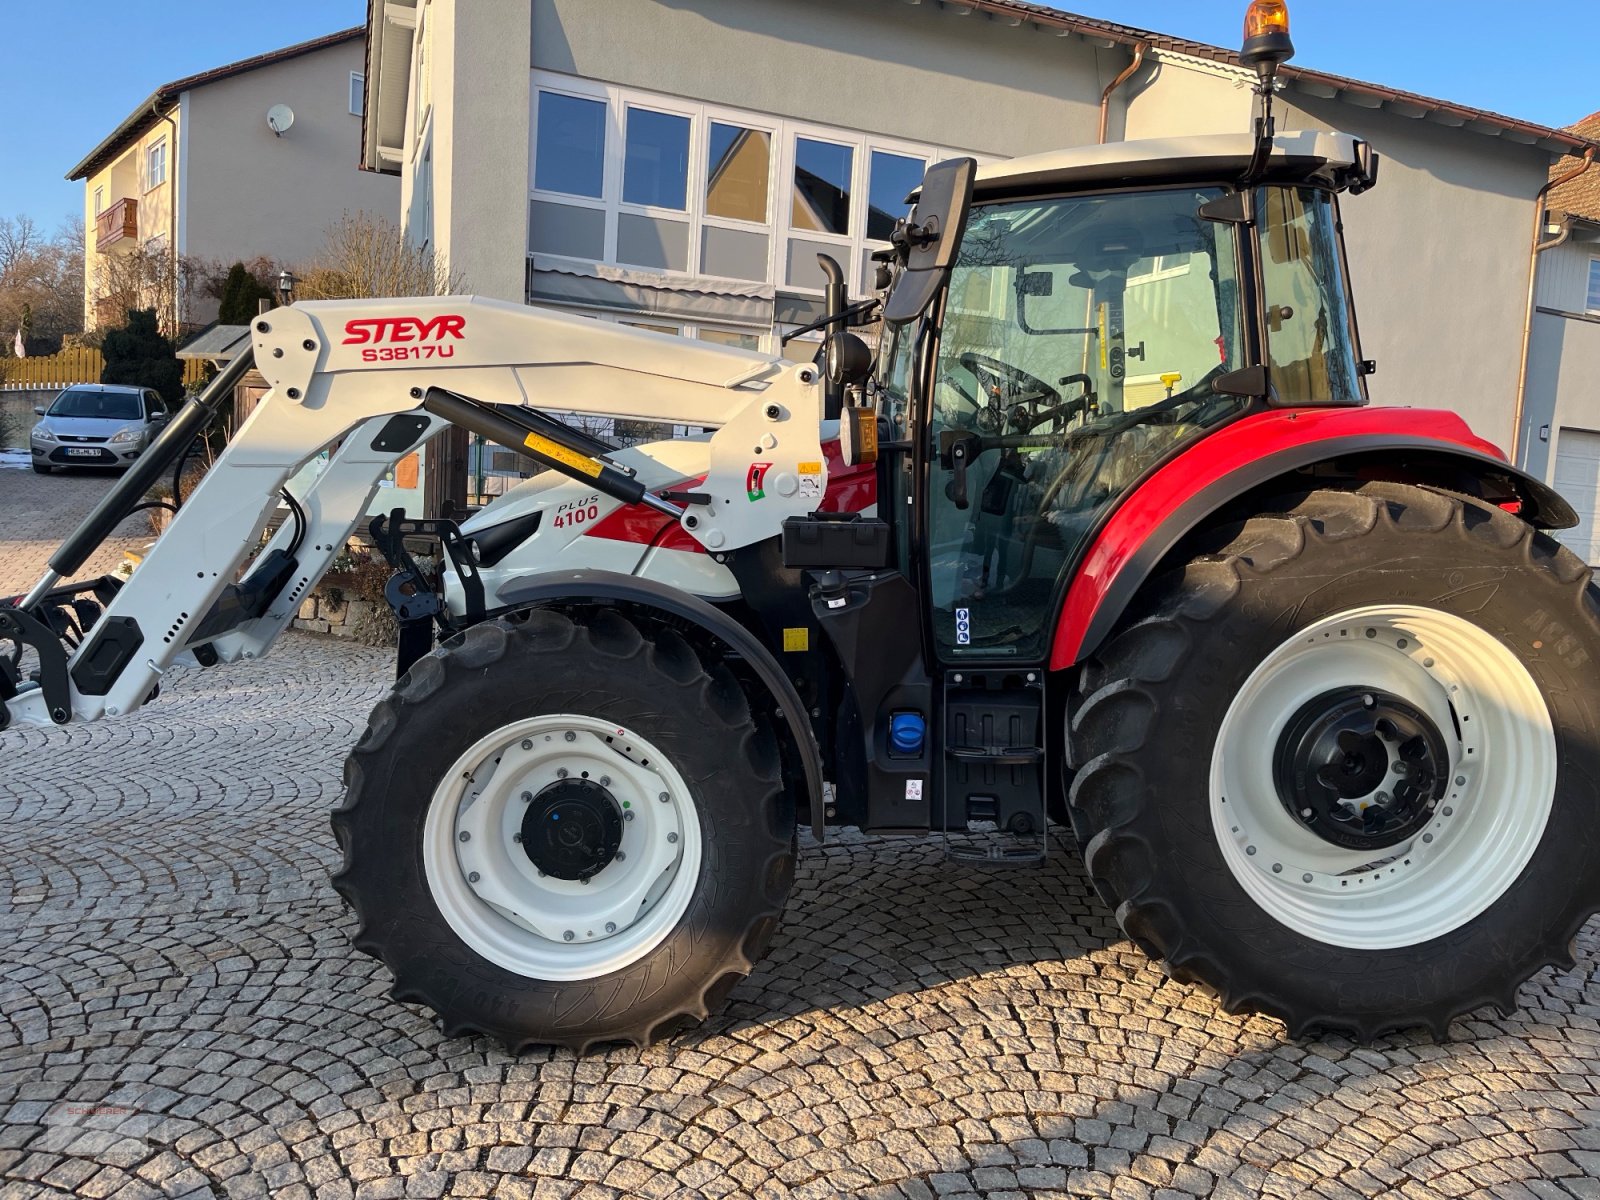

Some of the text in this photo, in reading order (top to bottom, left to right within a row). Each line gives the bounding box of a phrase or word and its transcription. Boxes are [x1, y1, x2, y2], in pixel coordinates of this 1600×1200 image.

[341, 315, 466, 345] STEYR
[362, 344, 454, 362] S3817U
[558, 495, 599, 513] PLUS
[553, 505, 598, 528] 4100
